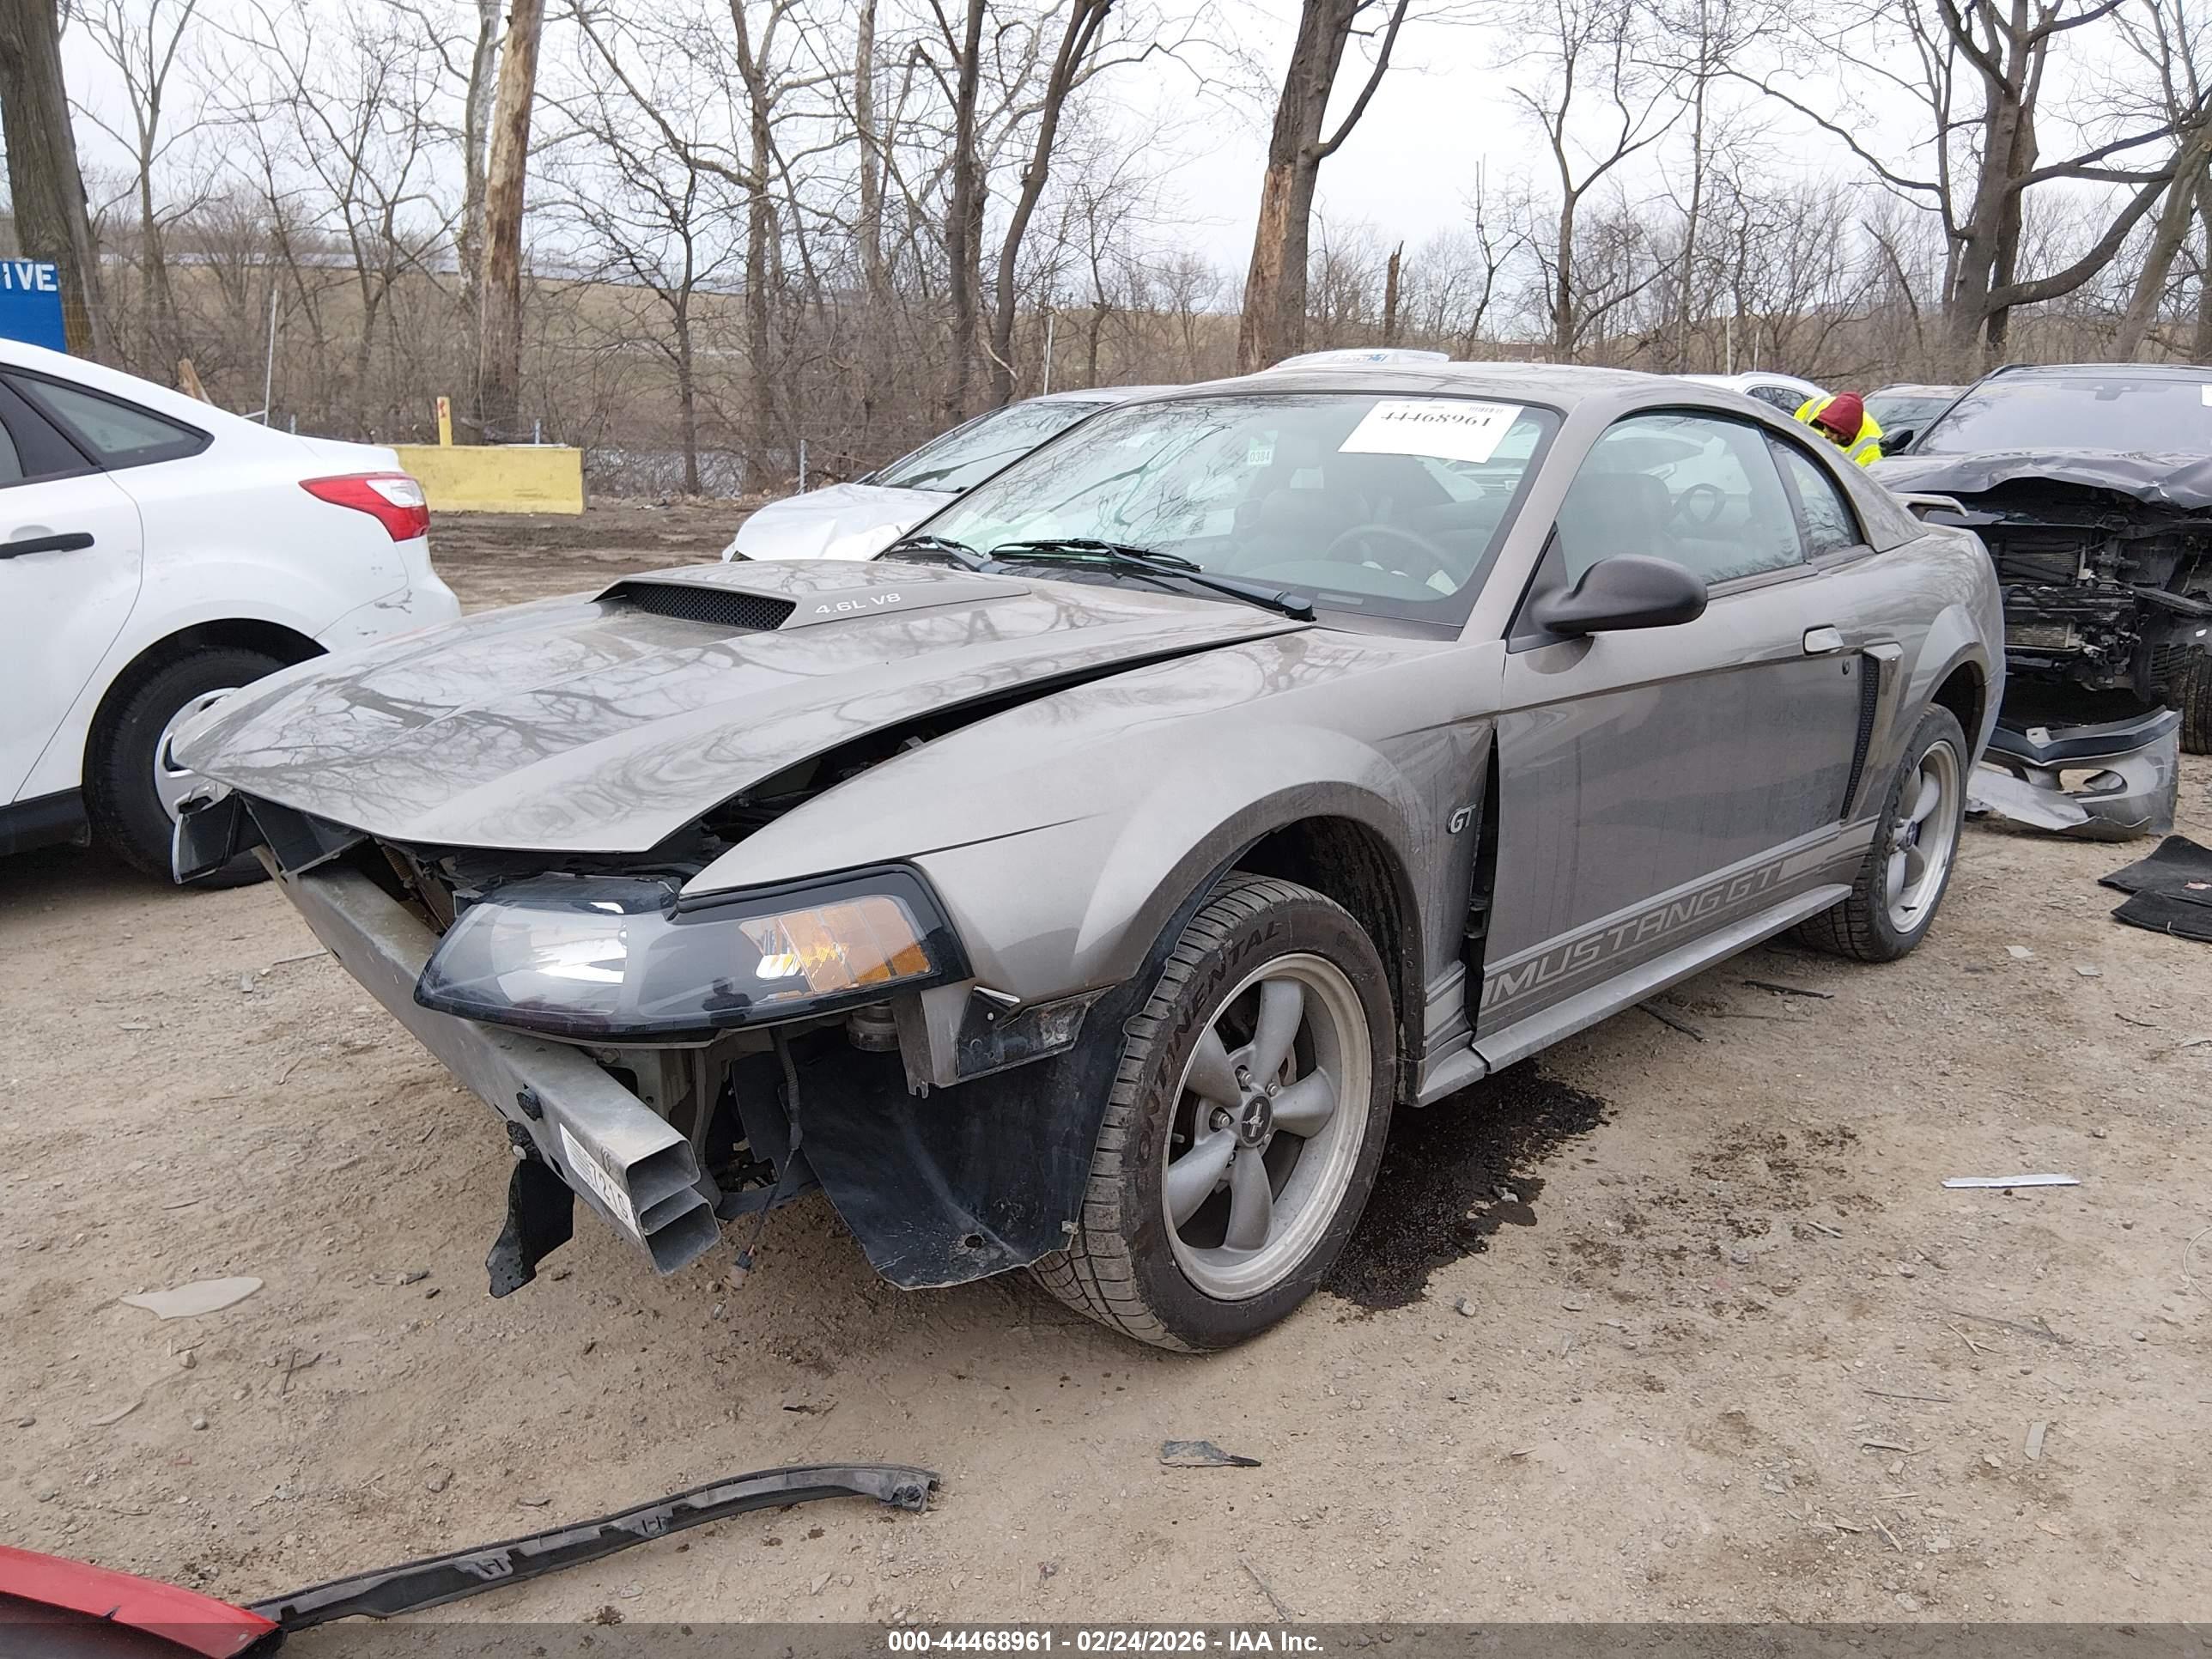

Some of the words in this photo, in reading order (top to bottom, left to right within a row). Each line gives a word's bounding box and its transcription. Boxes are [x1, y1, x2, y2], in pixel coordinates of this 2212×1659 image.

[3, 262, 58, 292] IVE
[1380, 411, 1492, 427] 44468961
[815, 599, 866, 614] 4.6L
[870, 592, 902, 605] V8
[1449, 804, 1477, 834] GT
[1491, 884, 1725, 1004] MUSTANG
[1725, 861, 1782, 903] GT
